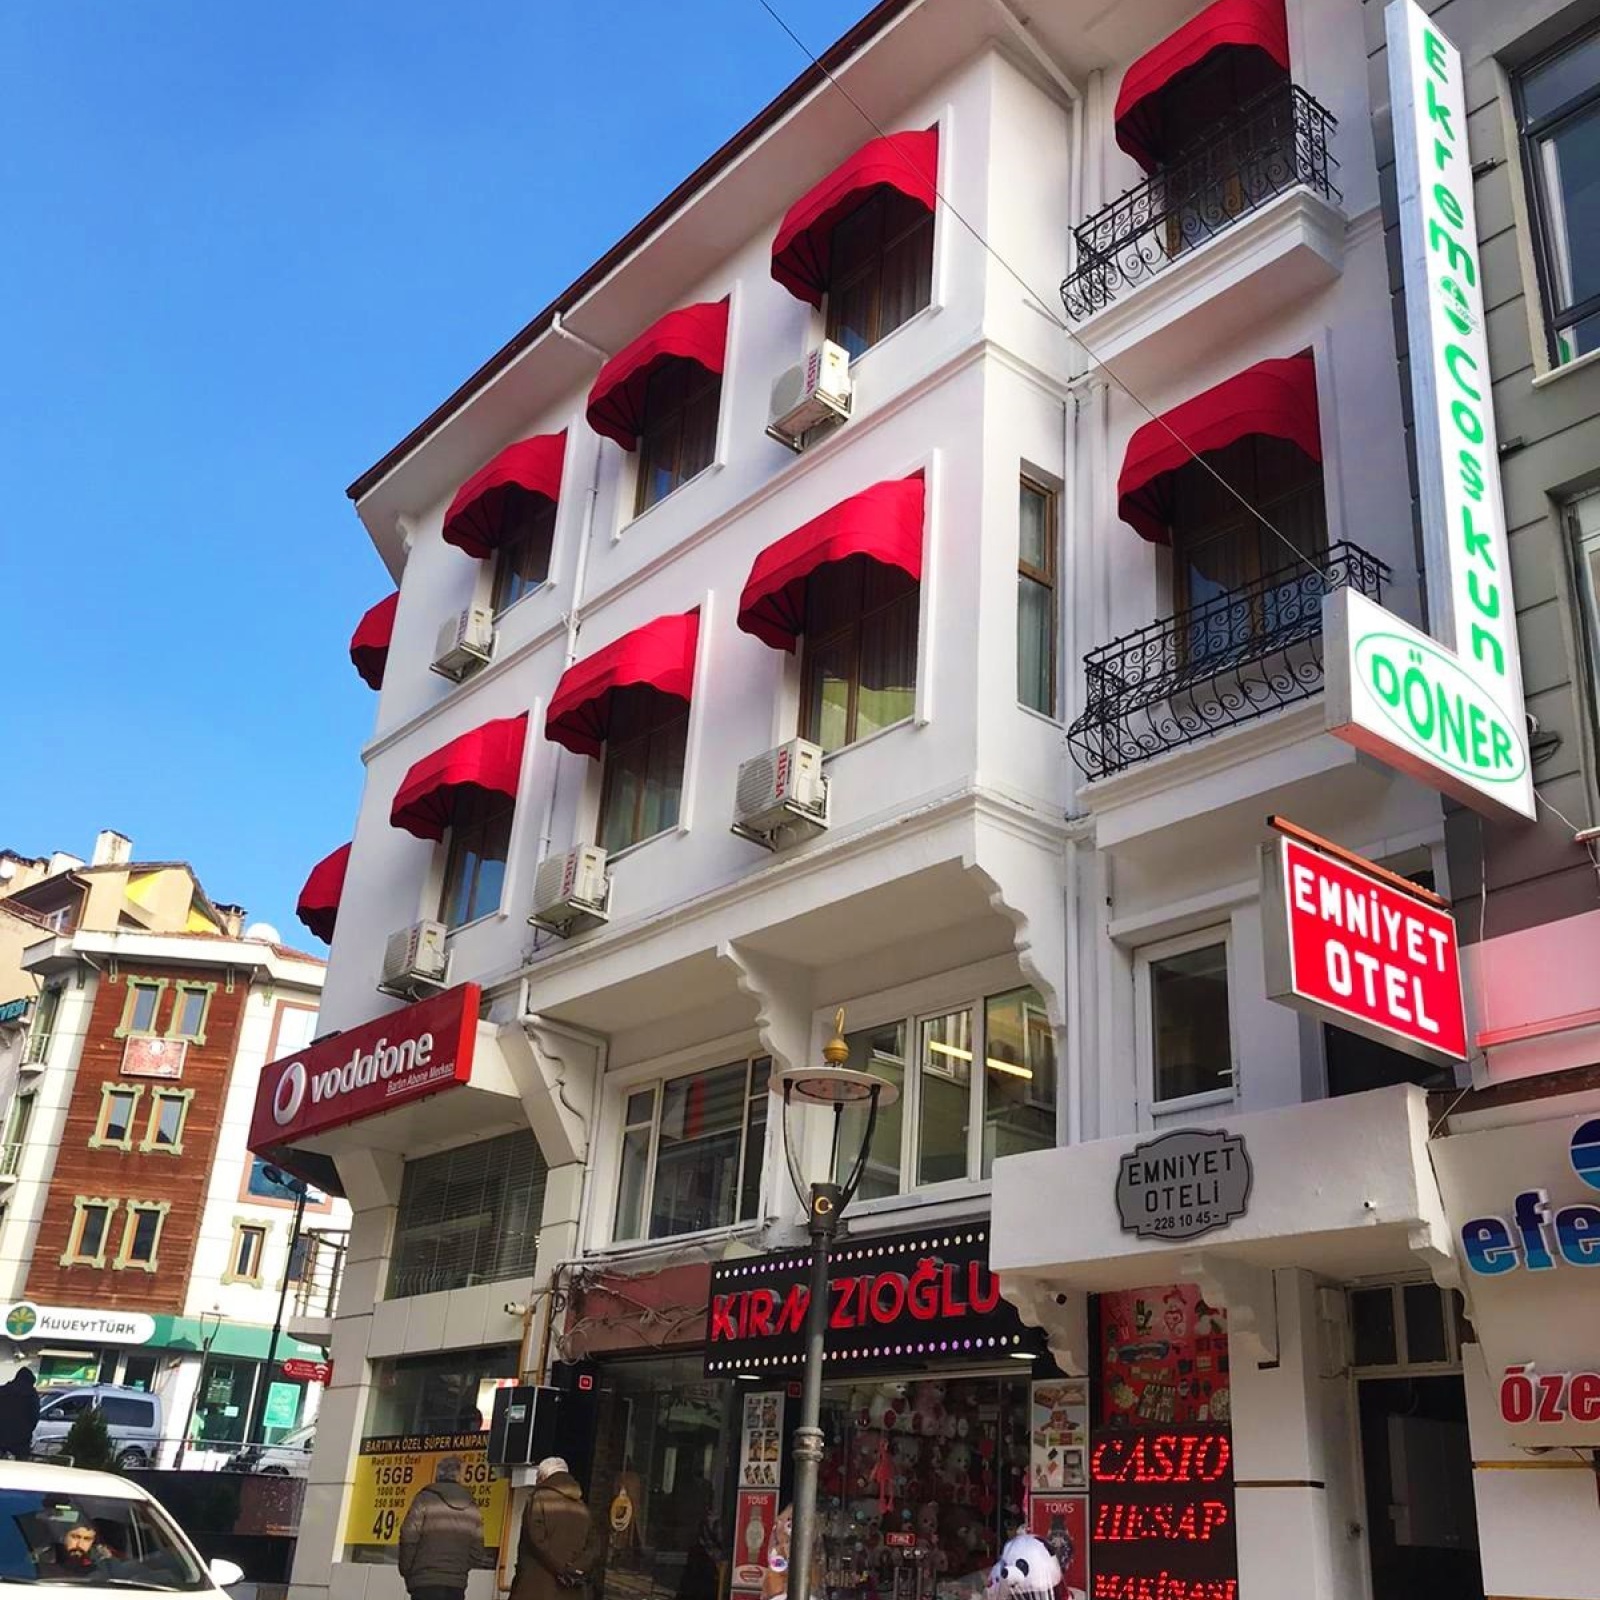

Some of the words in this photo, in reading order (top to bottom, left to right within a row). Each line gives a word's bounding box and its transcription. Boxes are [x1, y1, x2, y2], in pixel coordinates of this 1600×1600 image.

[1423, 26, 1476, 288] Ekrem
[1371, 648, 1514, 770] DÖNER
[1293, 863, 1449, 973] EMNİYET
[1325, 938, 1440, 1034] OTEL
[311, 1032, 433, 1103] vodafone
[1128, 1147, 1235, 1187] EMNİYET
[1145, 1180, 1220, 1212] OTELİ
[1154, 1217, 1176, 1231] 228
[1180, 1214, 1193, 1228] 10
[1196, 1211, 1211, 1225] 45
[711, 1257, 1000, 1342] KIRMZIOĞLU
[402, 1436, 422, 1451] ÖZEL
[423, 1434, 451, 1450] SÜPER
[1091, 1435, 1230, 1483] CASIO
[375, 1466, 414, 1485] 15GB
[395, 1486, 408, 1496] DK
[372, 1510, 396, 1540] 49
[1045, 1502, 1075, 1514] TOMS
[1093, 1501, 1228, 1541] HESAP
